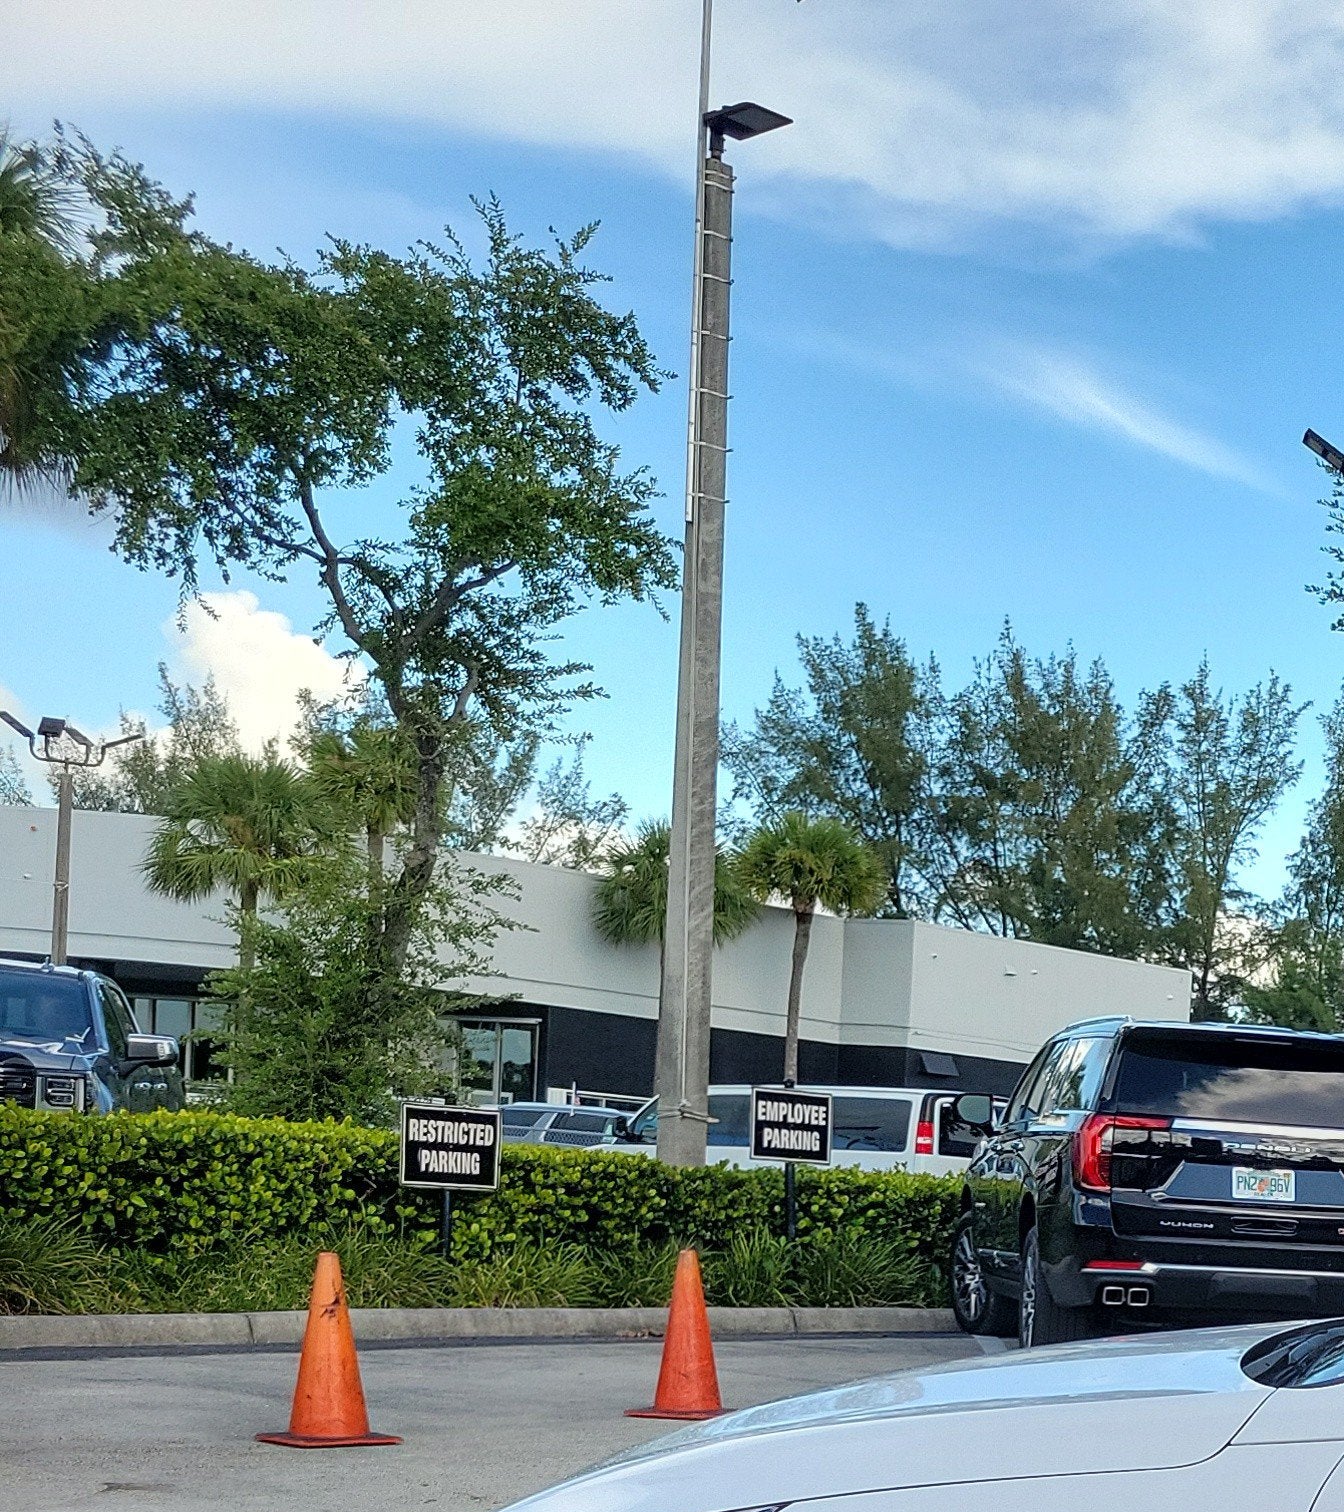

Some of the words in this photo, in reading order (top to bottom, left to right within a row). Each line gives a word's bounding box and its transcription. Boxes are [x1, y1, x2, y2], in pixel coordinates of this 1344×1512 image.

[757, 1099, 827, 1126] EMPLOYEE
[408, 1118, 495, 1147] RESTRICTED
[762, 1127, 820, 1152] PARKING
[419, 1149, 481, 1175] PARKING
